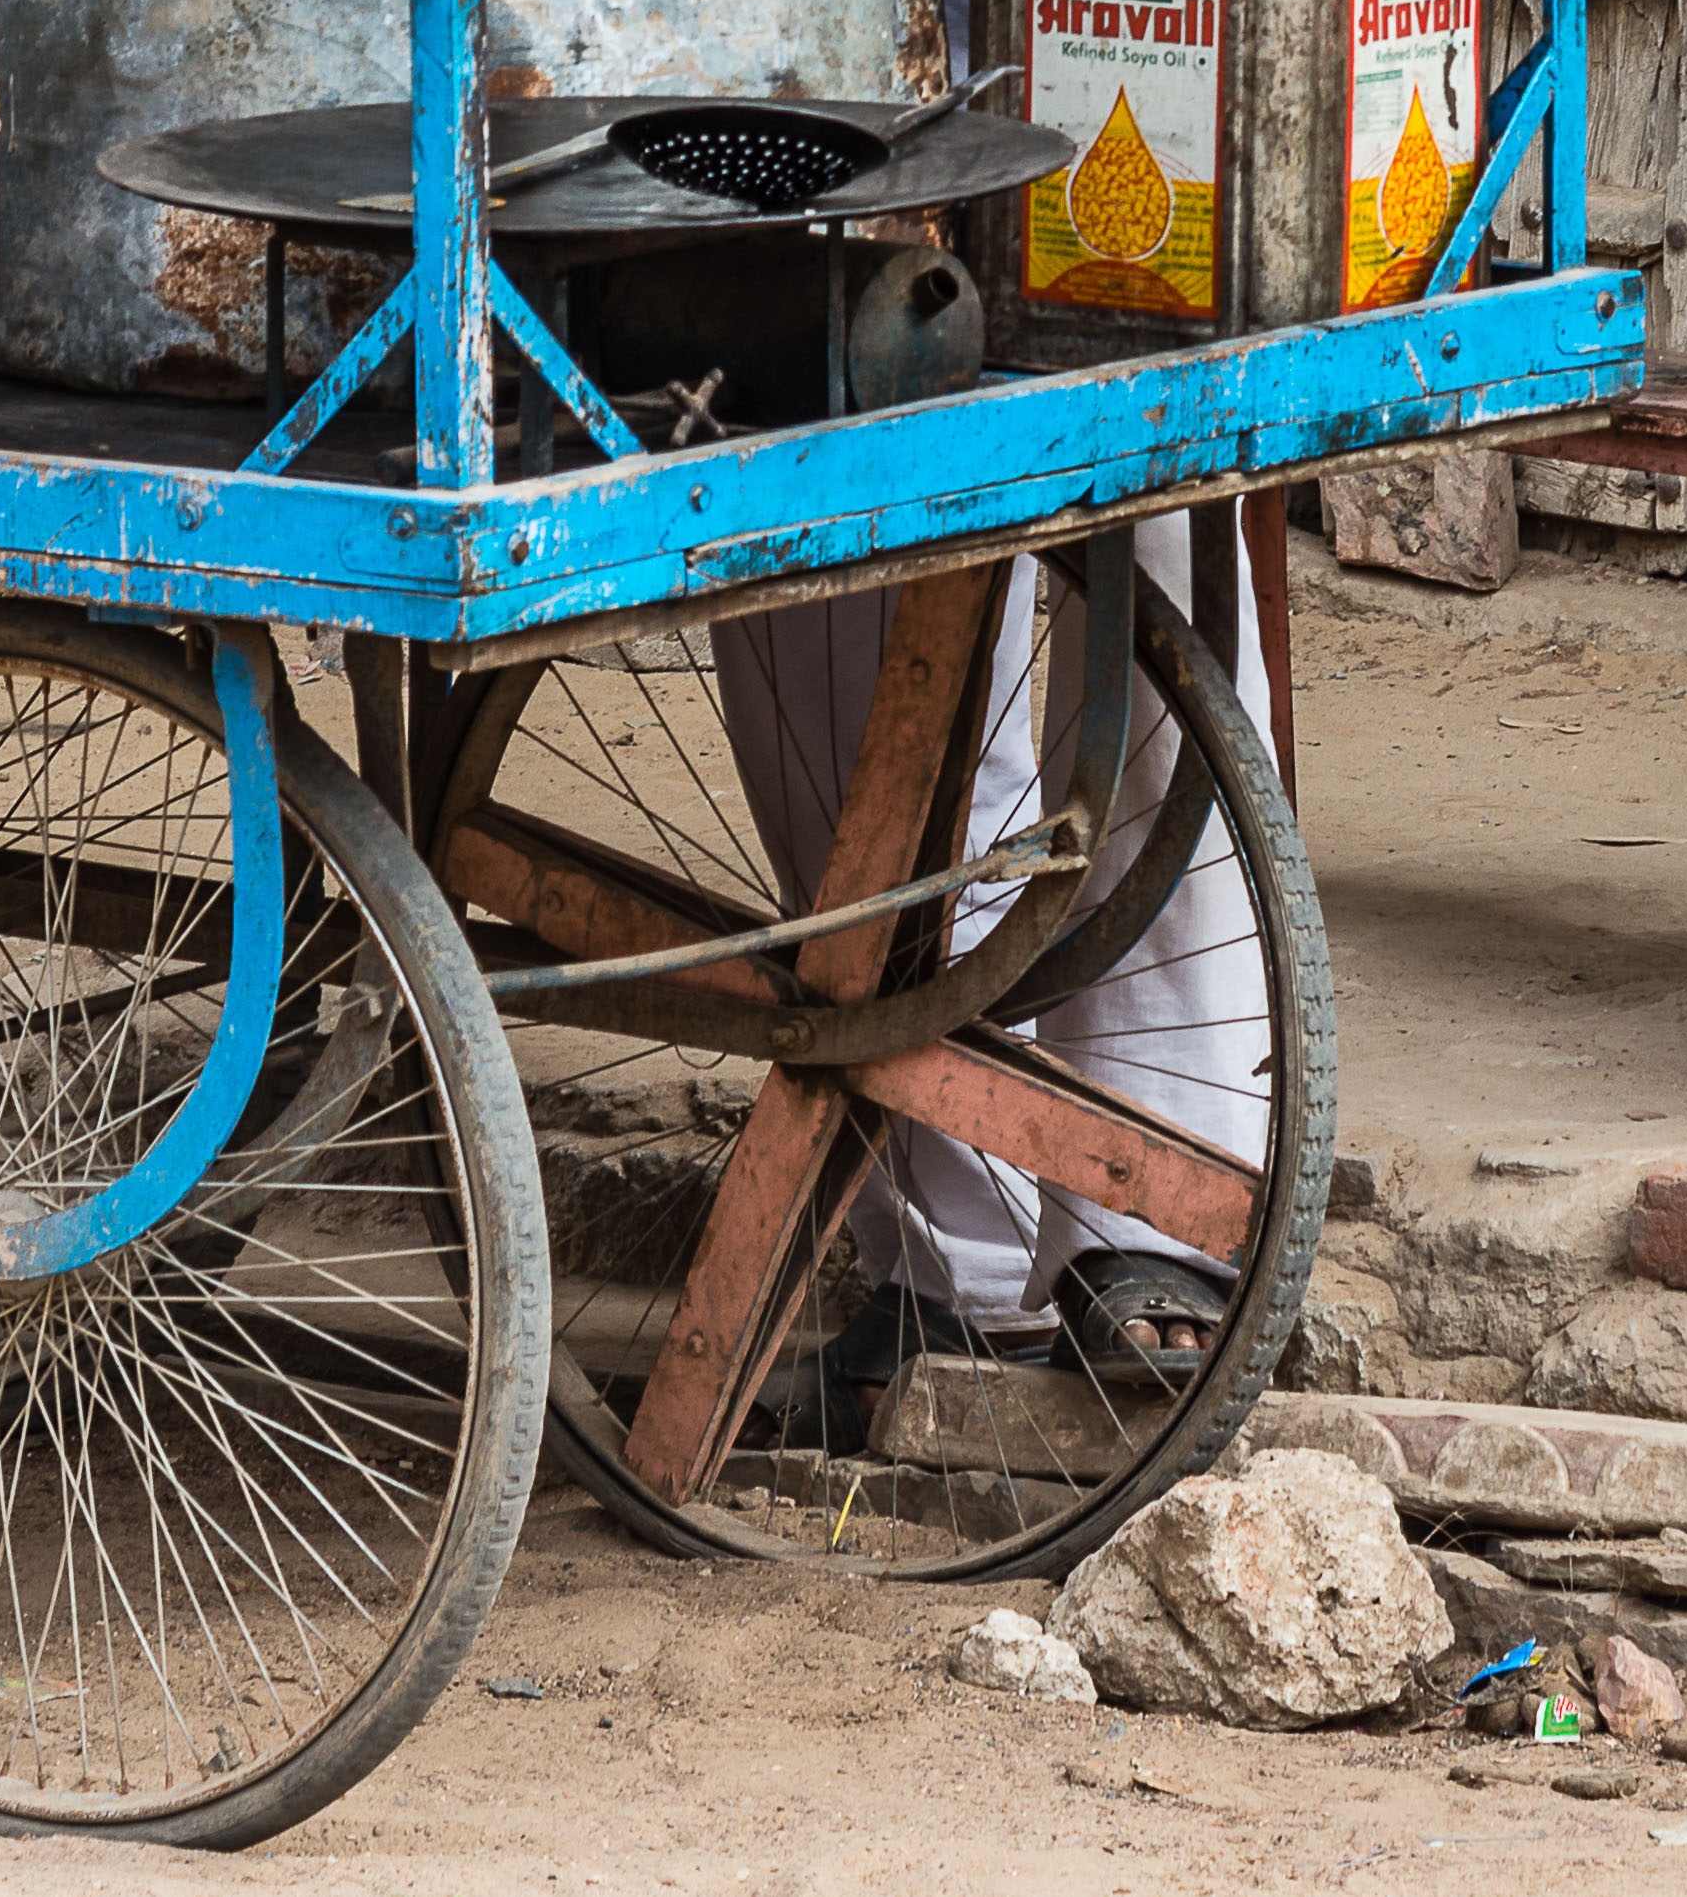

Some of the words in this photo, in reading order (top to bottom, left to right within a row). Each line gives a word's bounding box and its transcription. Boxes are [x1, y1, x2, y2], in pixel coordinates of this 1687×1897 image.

[1062, 41, 1117, 63] Refined
[1121, 47, 1158, 67] Soya
[1163, 51, 1186, 67] Oil
